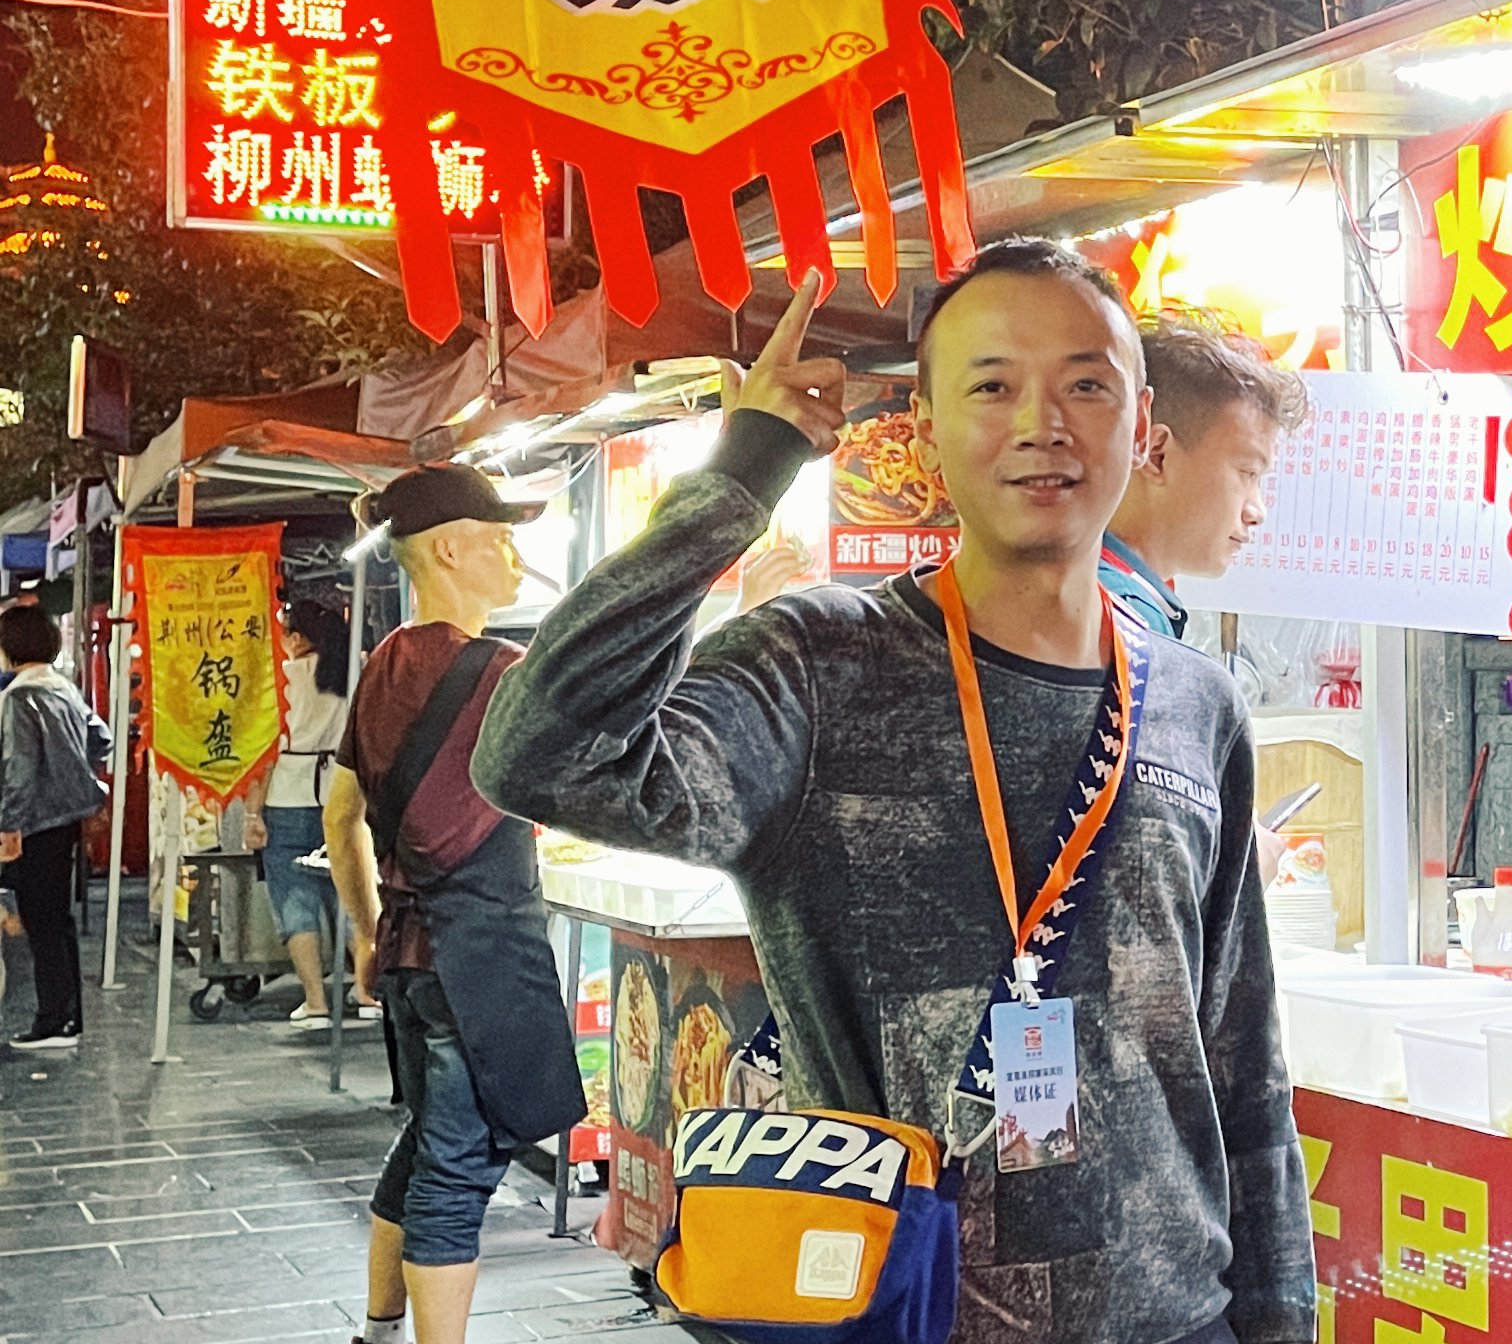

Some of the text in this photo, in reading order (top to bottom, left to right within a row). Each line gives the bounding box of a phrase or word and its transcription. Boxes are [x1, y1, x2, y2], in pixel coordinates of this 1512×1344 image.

[191, 651, 241, 769] 锅盔
[1135, 762, 1218, 810] CATERPILLAR
[674, 1111, 907, 1203] KAPPA
